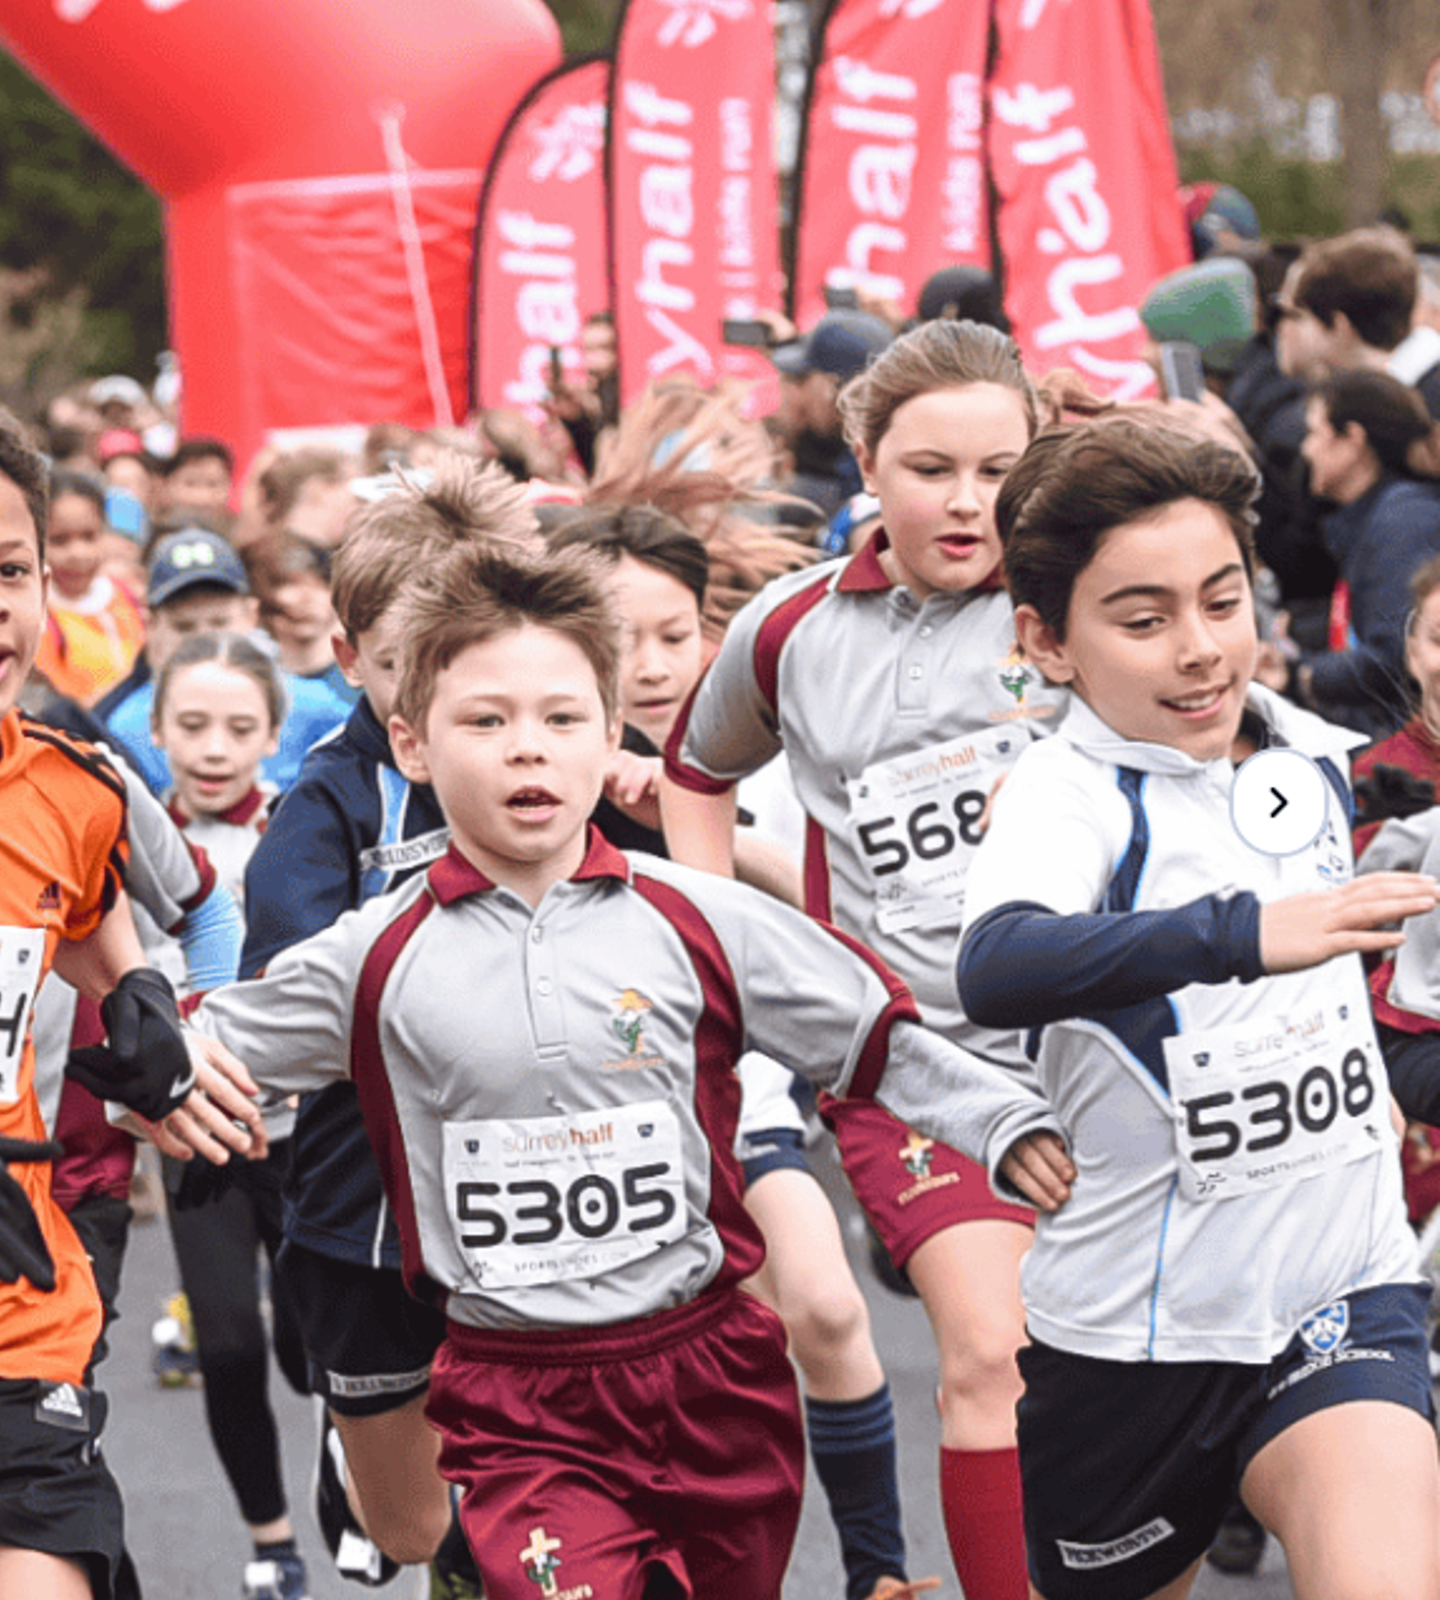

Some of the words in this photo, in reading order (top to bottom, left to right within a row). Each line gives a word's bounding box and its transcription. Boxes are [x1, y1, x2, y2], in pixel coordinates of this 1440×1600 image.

[497, 210, 581, 407] half
[857, 790, 988, 877] 568
[503, 1122, 613, 1156] surreyhalf
[1187, 1048, 1375, 1163] 5308
[456, 1162, 677, 1248] 5305
